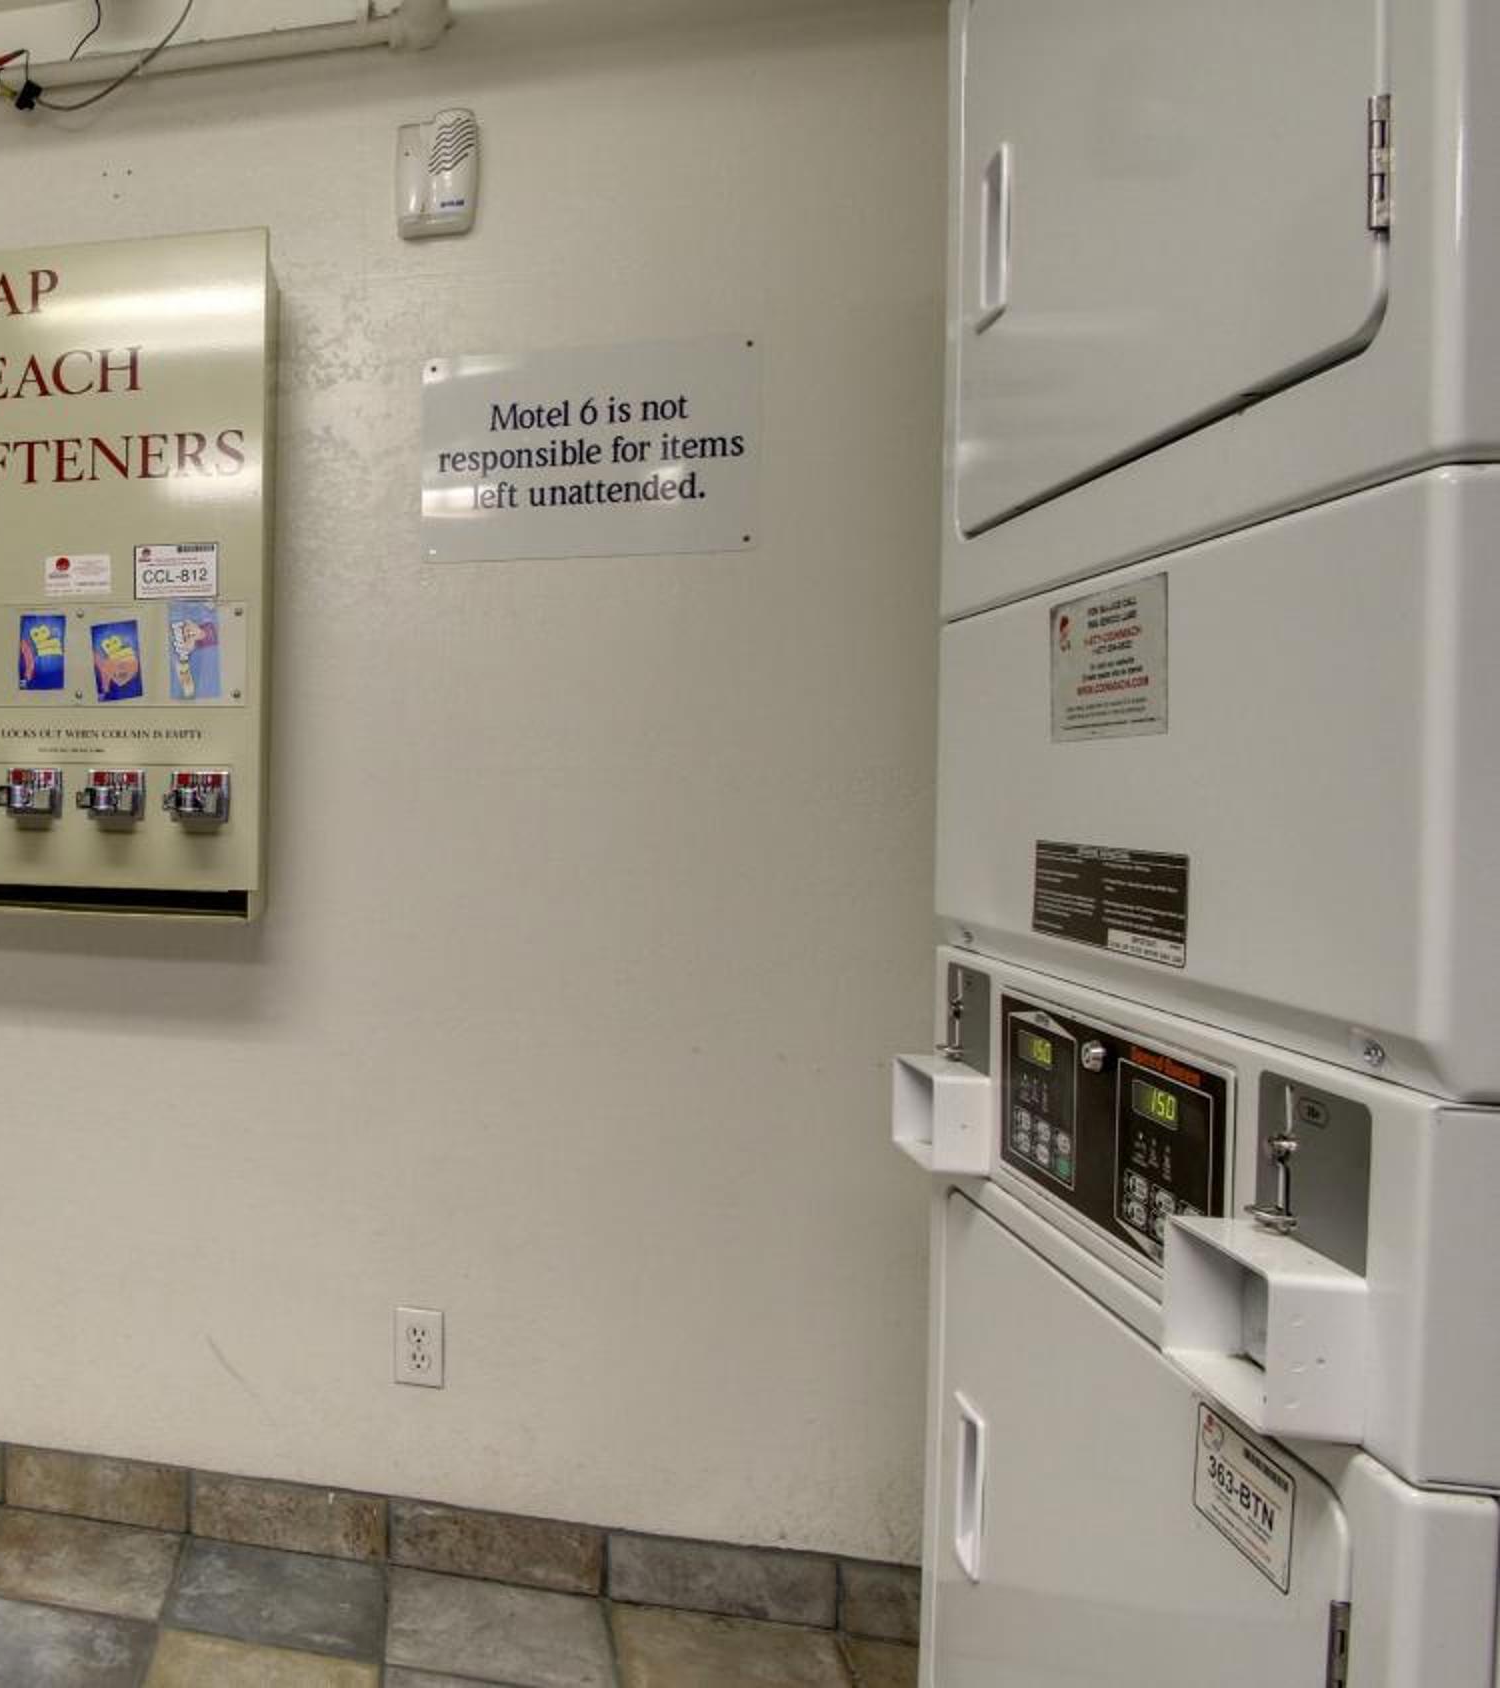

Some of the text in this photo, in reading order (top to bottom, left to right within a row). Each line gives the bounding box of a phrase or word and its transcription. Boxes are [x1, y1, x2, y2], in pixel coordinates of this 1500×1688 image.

[489, 395, 689, 432] Motel 6 is not
[438, 432, 745, 478] responsible for items
[472, 471, 706, 511] left unattended.
[142, 567, 209, 585] CCL-812
[1, 729, 37, 739] LOCKS
[1207, 1454, 1276, 1532] 363-BTN
